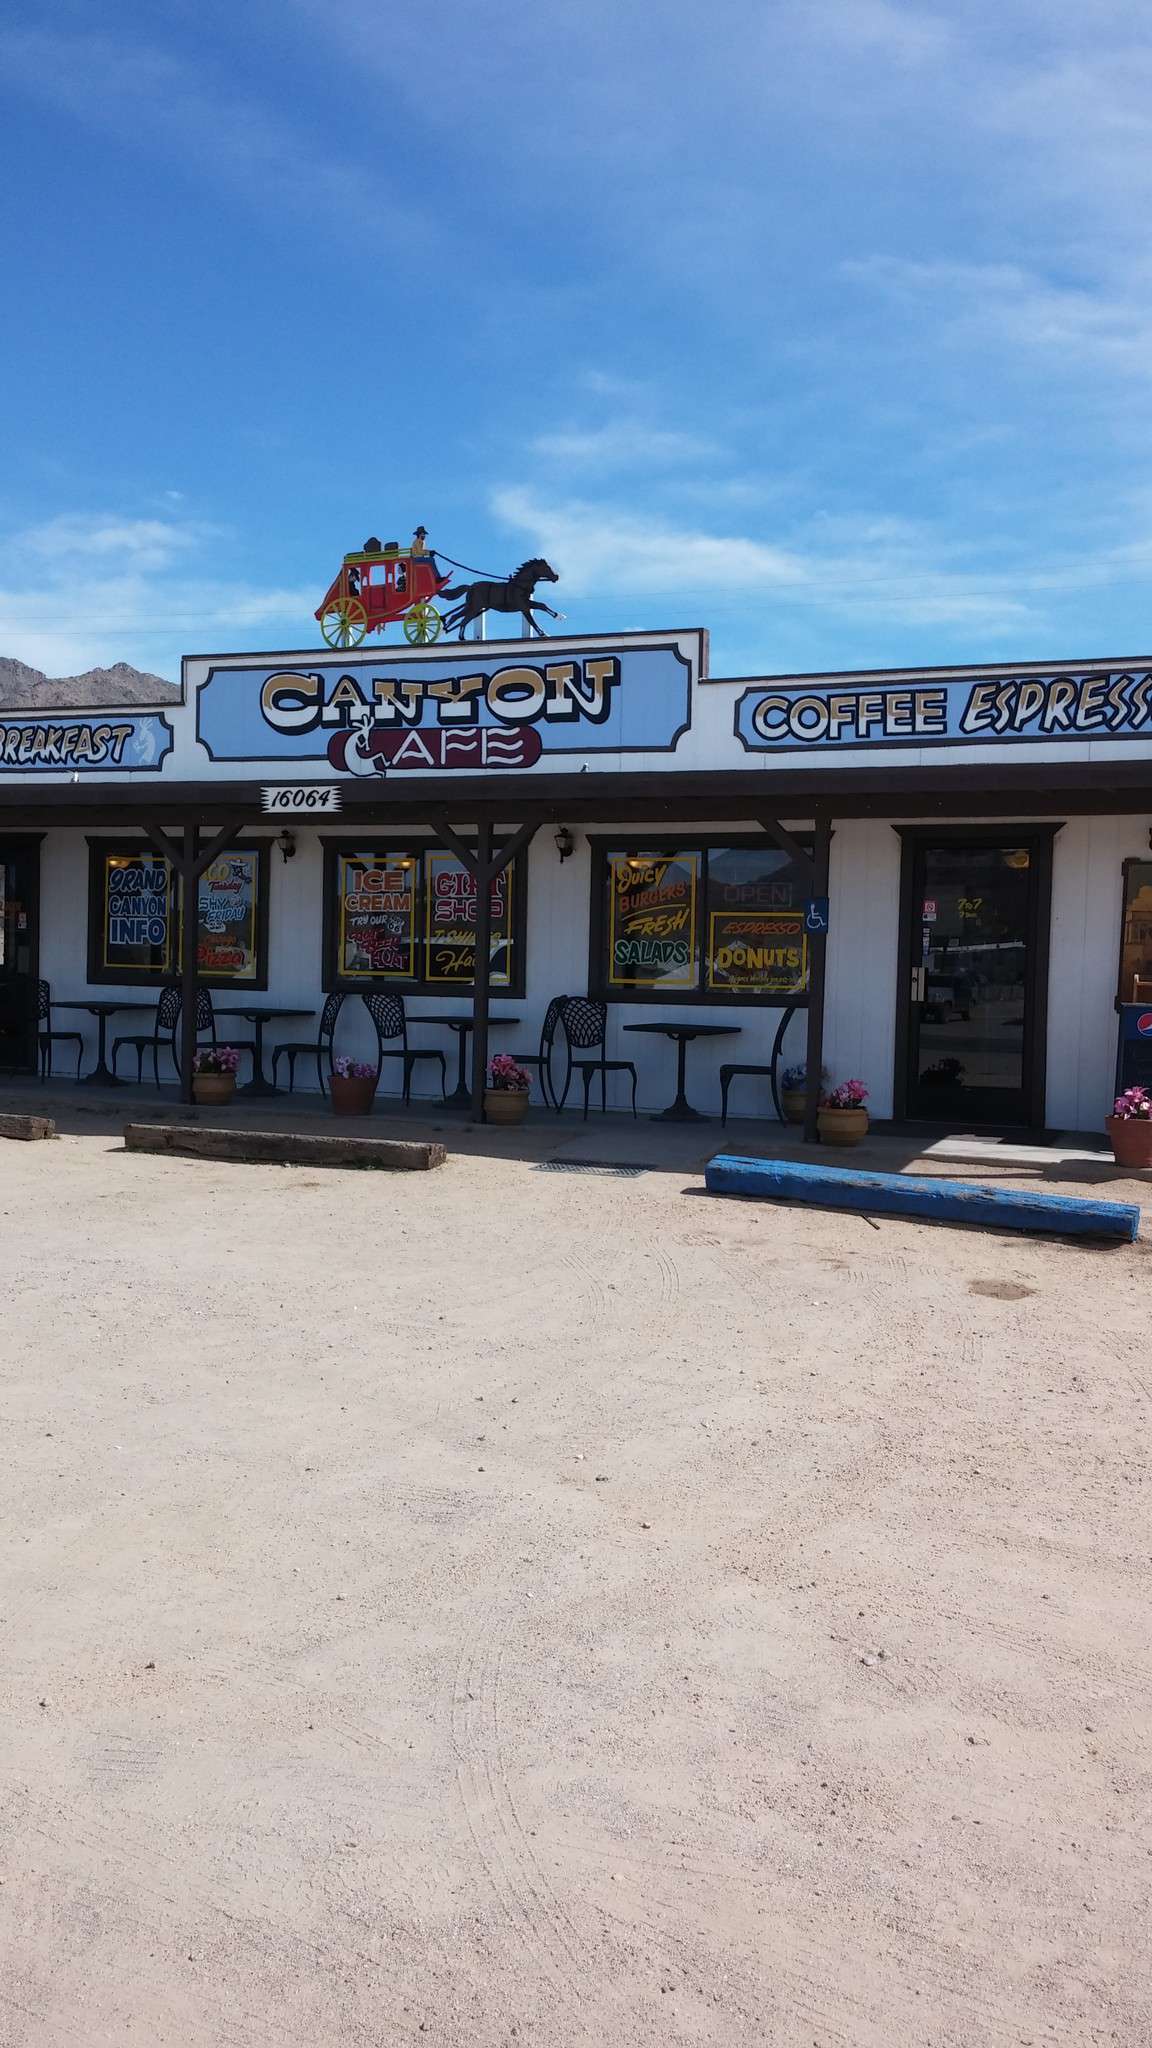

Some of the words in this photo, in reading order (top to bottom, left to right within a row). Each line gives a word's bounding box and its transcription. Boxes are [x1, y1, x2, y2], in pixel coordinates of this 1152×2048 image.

[260, 656, 621, 736] CANYON
[751, 687, 948, 742] COFFEE
[343, 714, 526, 777] CAFE
[271, 789, 332, 808] 16064
[109, 867, 168, 893] GRAND
[353, 869, 405, 893] ICE
[108, 895, 168, 917] CANYON
[345, 893, 411, 912] CREAM
[620, 880, 687, 913] BURGERS
[724, 886, 786, 904] OPEN
[207, 905, 247, 921] FRIDAY
[350, 916, 369, 927] TRY
[369, 914, 388, 926] OUR
[623, 907, 690, 936] FRESH
[109, 917, 166, 945] INFO
[721, 921, 801, 935] ESPRESSO
[614, 939, 690, 965] SALADS
[718, 946, 801, 969] DONUTS
